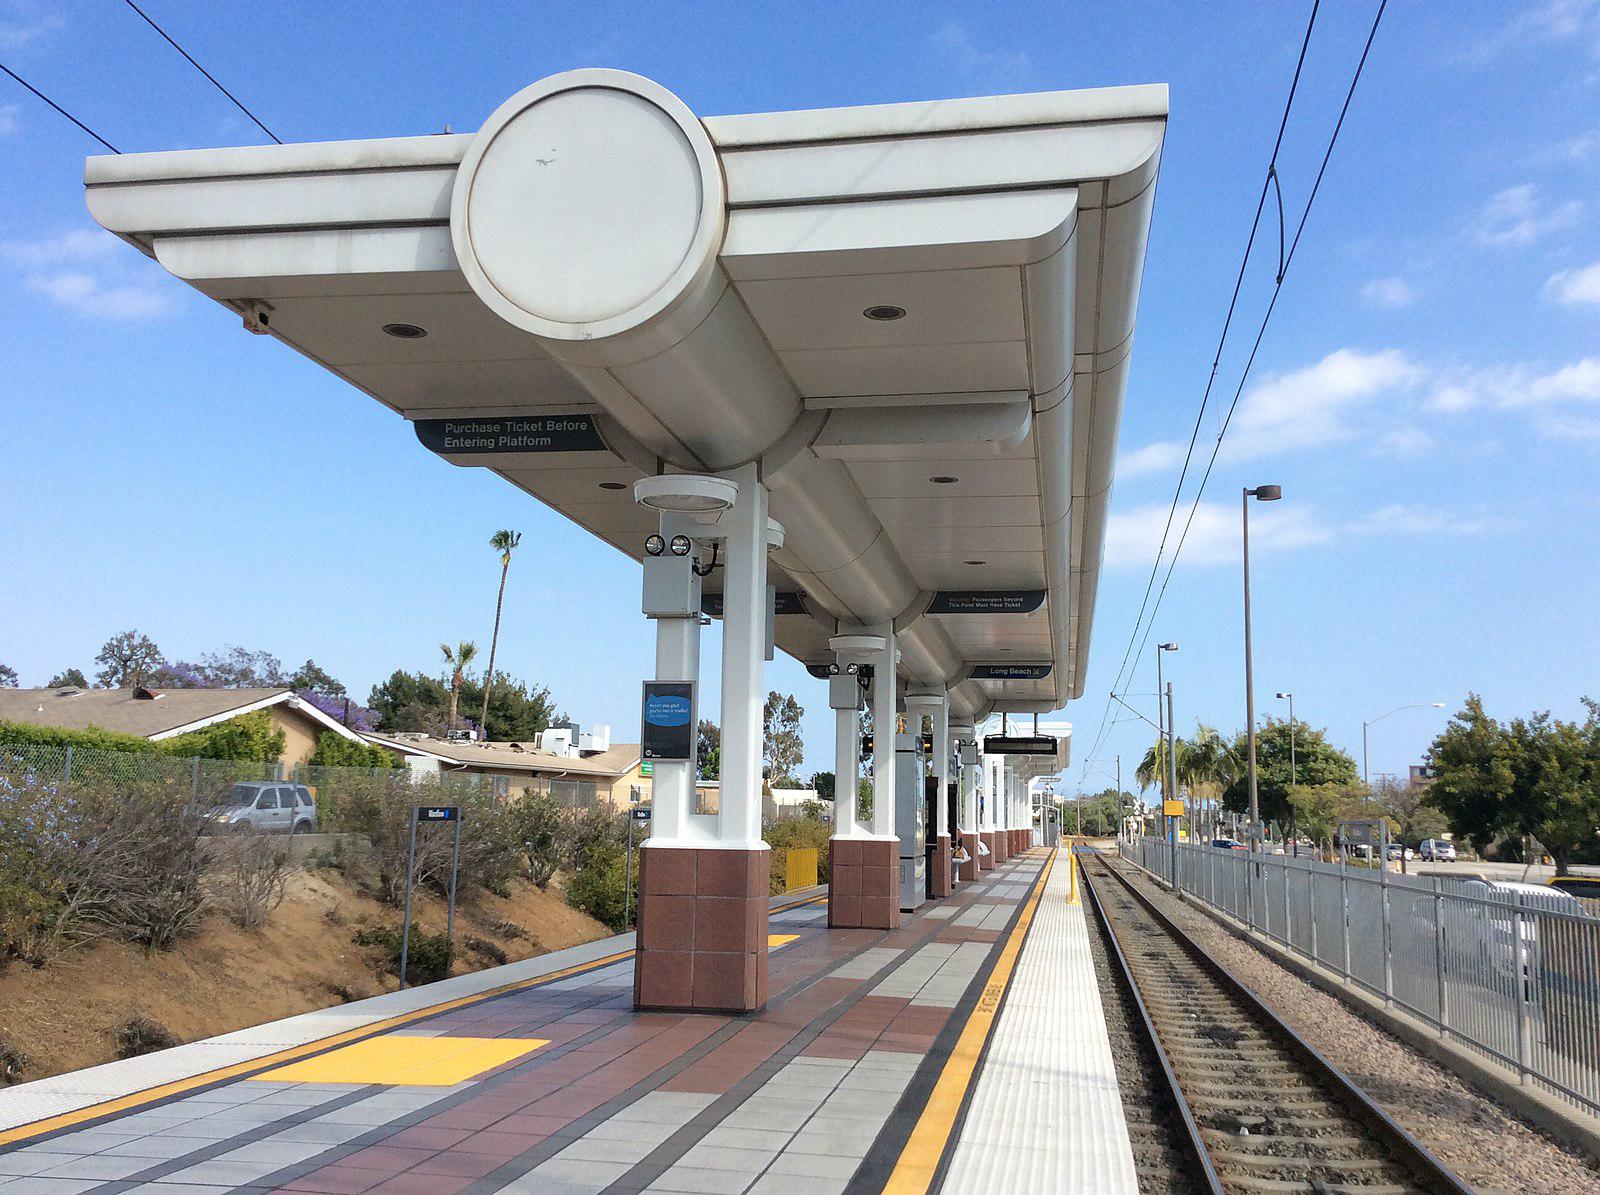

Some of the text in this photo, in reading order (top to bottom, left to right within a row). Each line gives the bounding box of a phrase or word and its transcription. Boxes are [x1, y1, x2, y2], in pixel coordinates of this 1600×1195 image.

[444, 420, 588, 433] Purchase Ticket Before
[444, 435, 552, 449] Entering Platform
[1009, 667, 1032, 675] Beach
